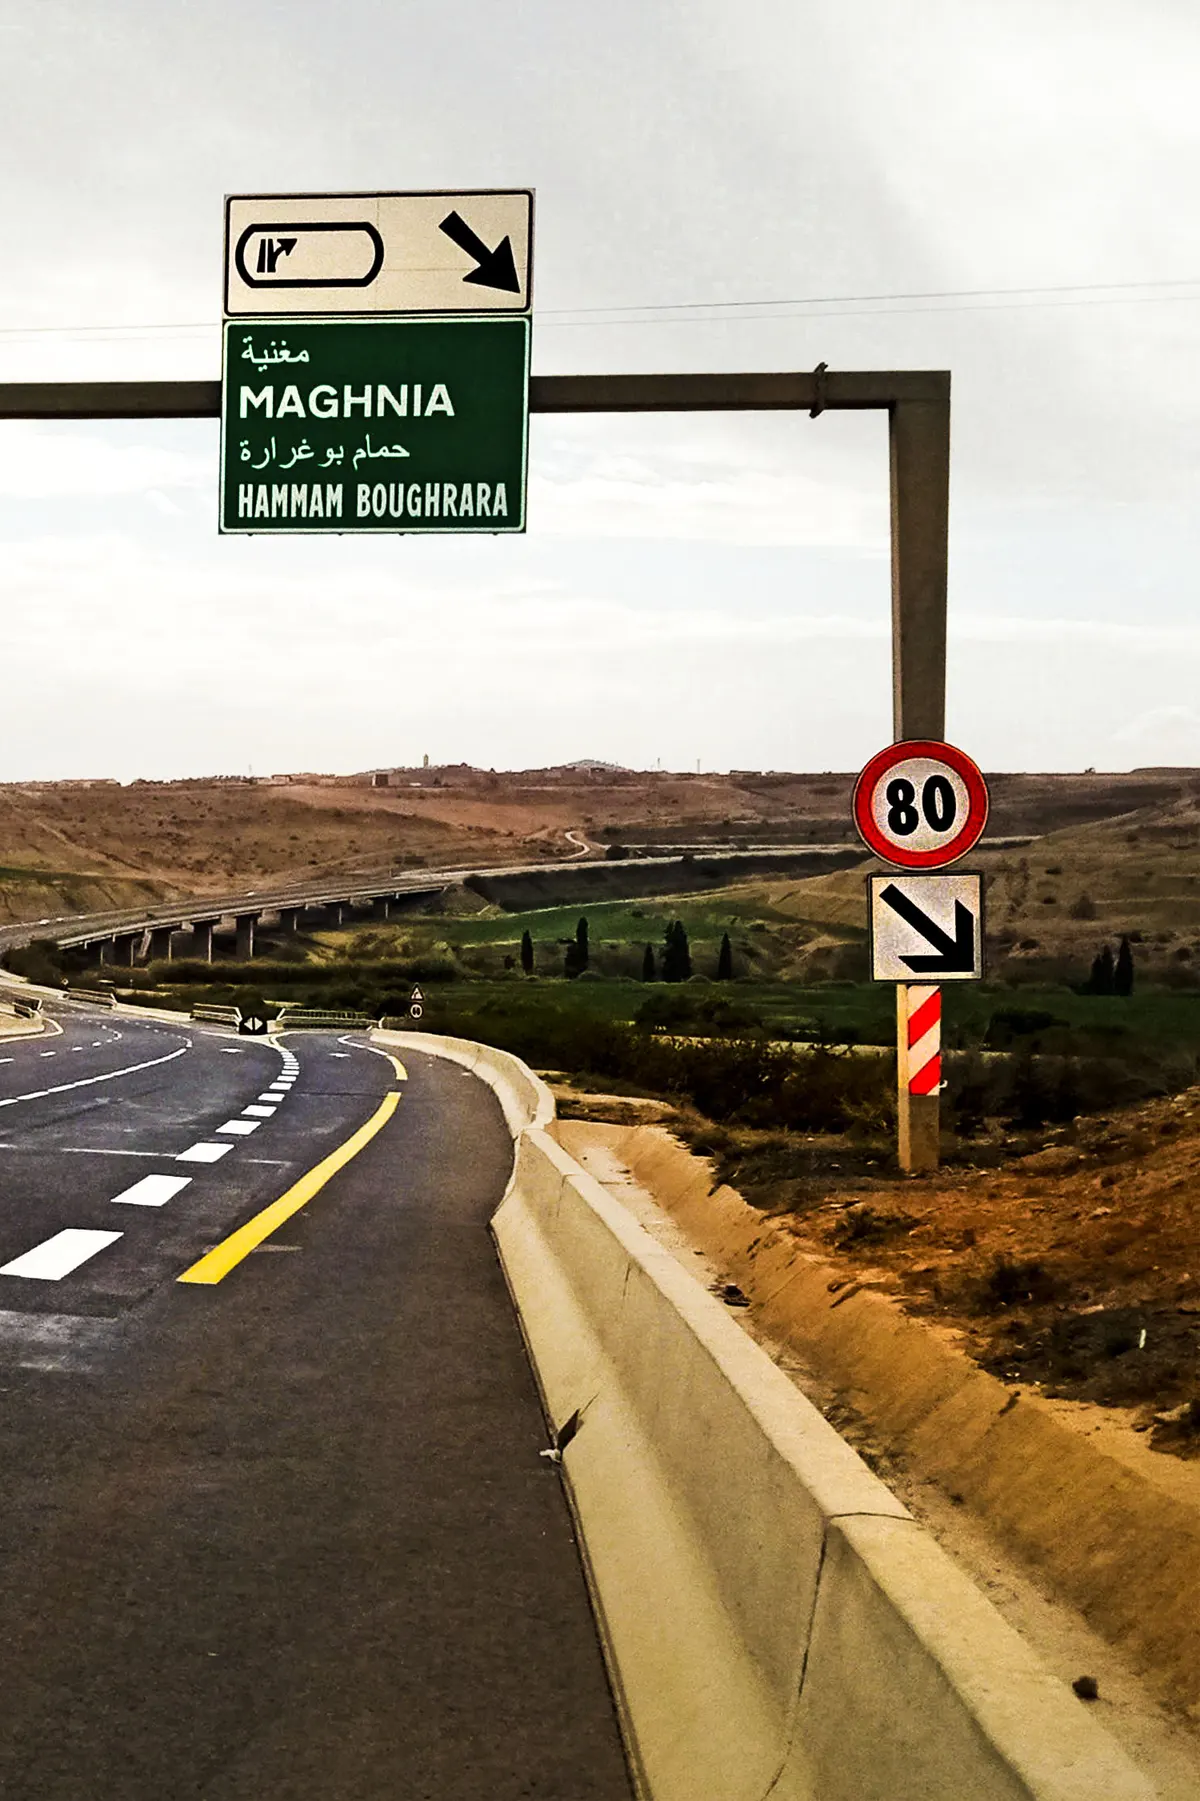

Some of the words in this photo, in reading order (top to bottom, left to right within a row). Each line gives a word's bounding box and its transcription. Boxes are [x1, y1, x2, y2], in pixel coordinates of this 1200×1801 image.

[240, 335, 310, 372] مغنية
[239, 383, 456, 419] MAGHNIA
[352, 433, 410, 470] حمام
[238, 484, 344, 518] HAMMAM
[356, 482, 508, 518] BOUGHRARA
[886, 775, 956, 836] 80
